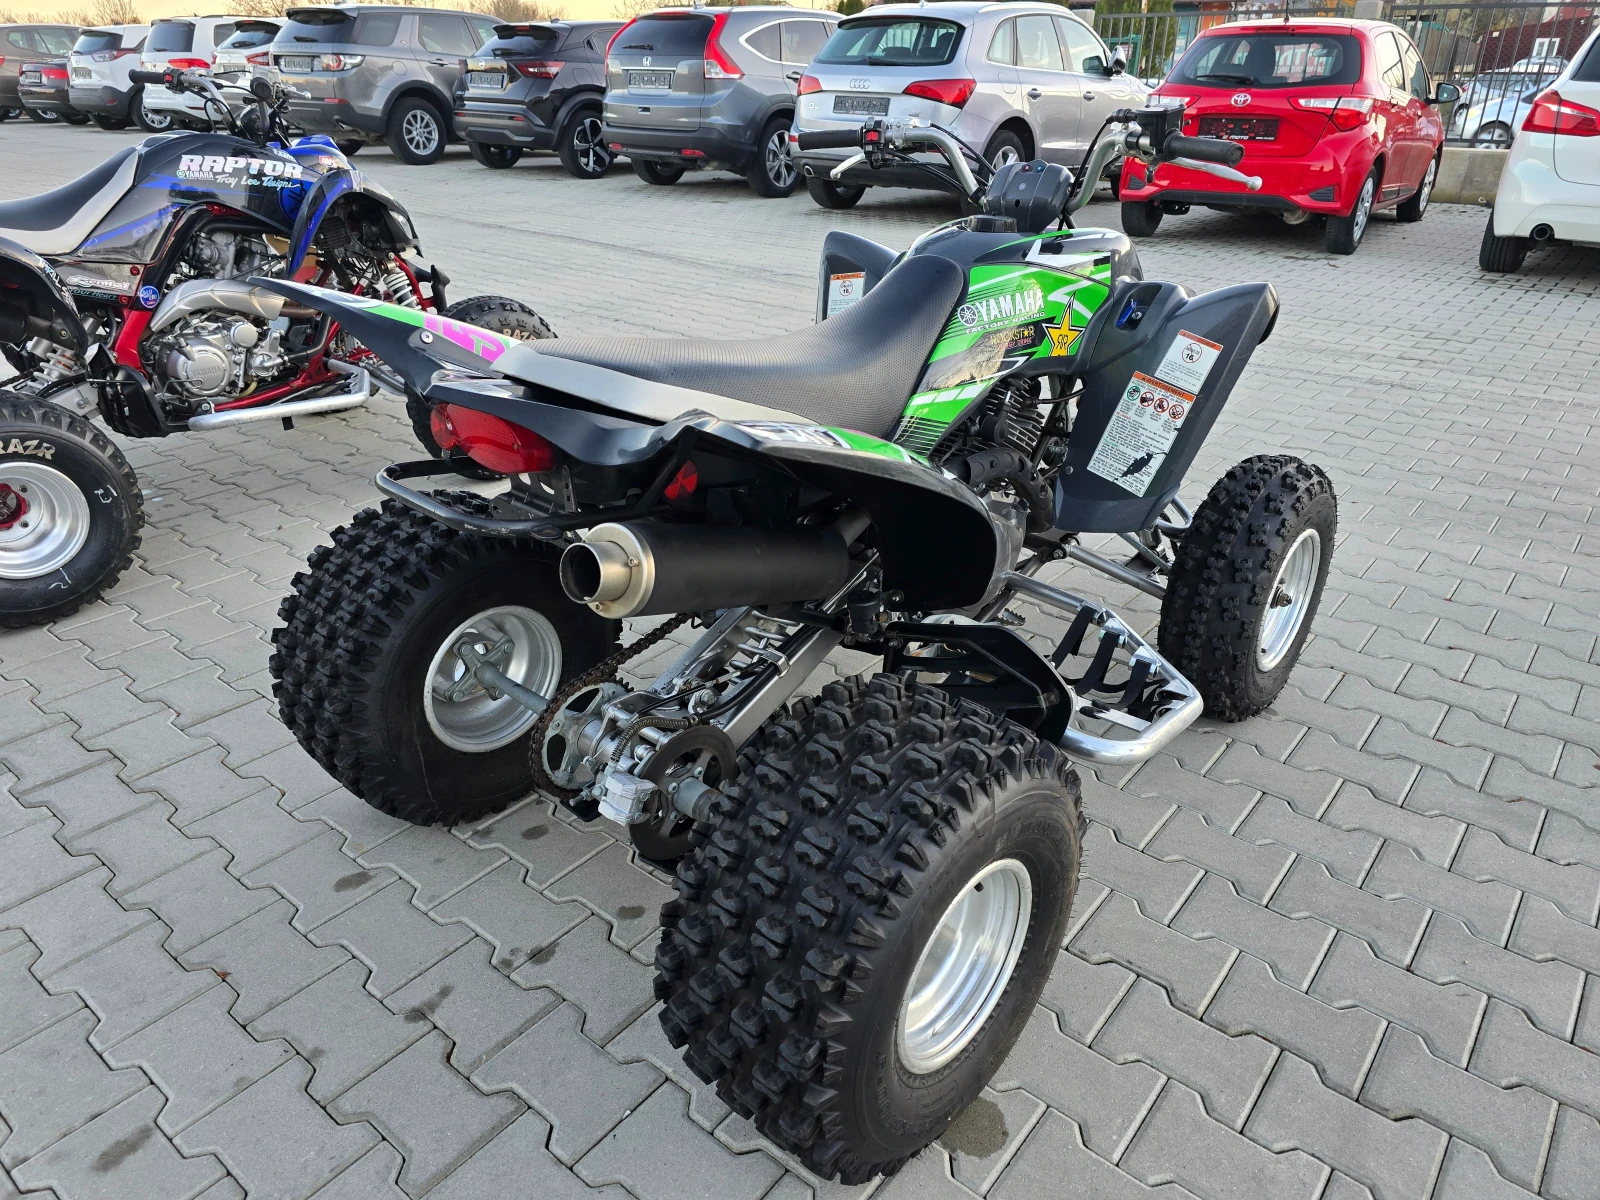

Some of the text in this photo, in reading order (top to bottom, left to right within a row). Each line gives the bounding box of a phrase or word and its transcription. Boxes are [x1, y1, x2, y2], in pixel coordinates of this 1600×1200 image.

[178, 155, 303, 178] RAPTOR
[185, 170, 214, 179] YAMAHA
[215, 174, 238, 188] Troy
[975, 289, 1044, 322] YAMAHA
[965, 311, 1046, 334] FACTORY RACING
[1185, 353, 1194, 361] 16
